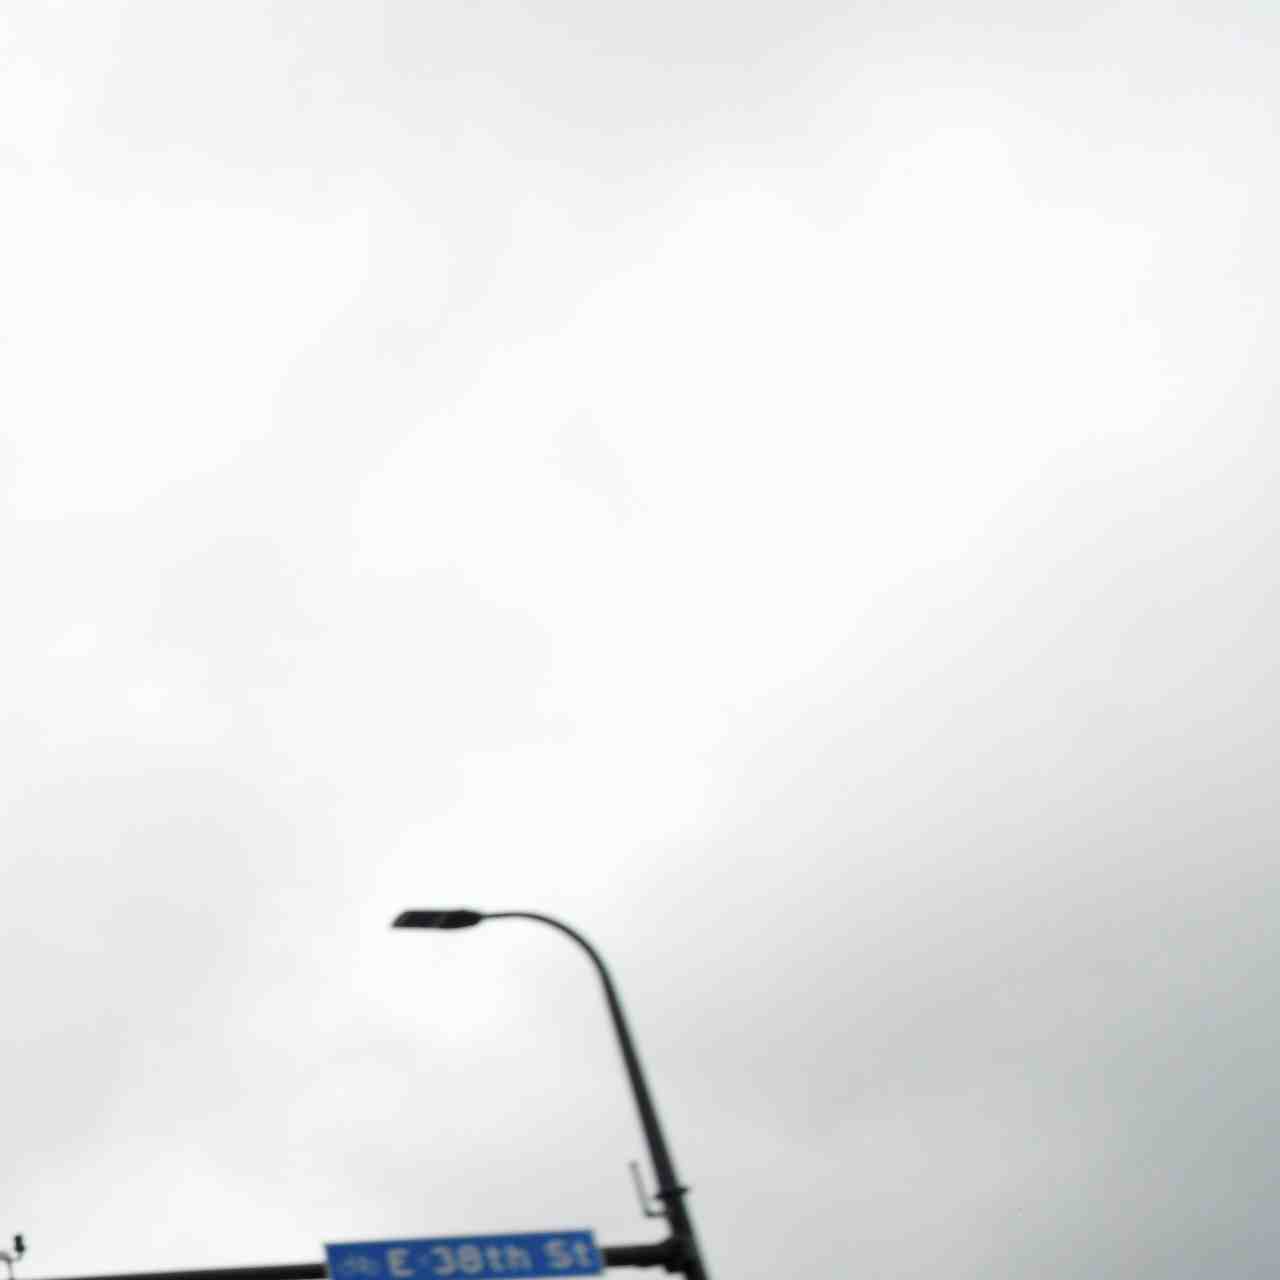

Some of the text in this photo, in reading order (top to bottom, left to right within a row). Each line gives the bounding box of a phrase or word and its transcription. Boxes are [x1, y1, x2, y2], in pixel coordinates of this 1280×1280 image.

[388, 1238, 594, 1276] E 38th St
